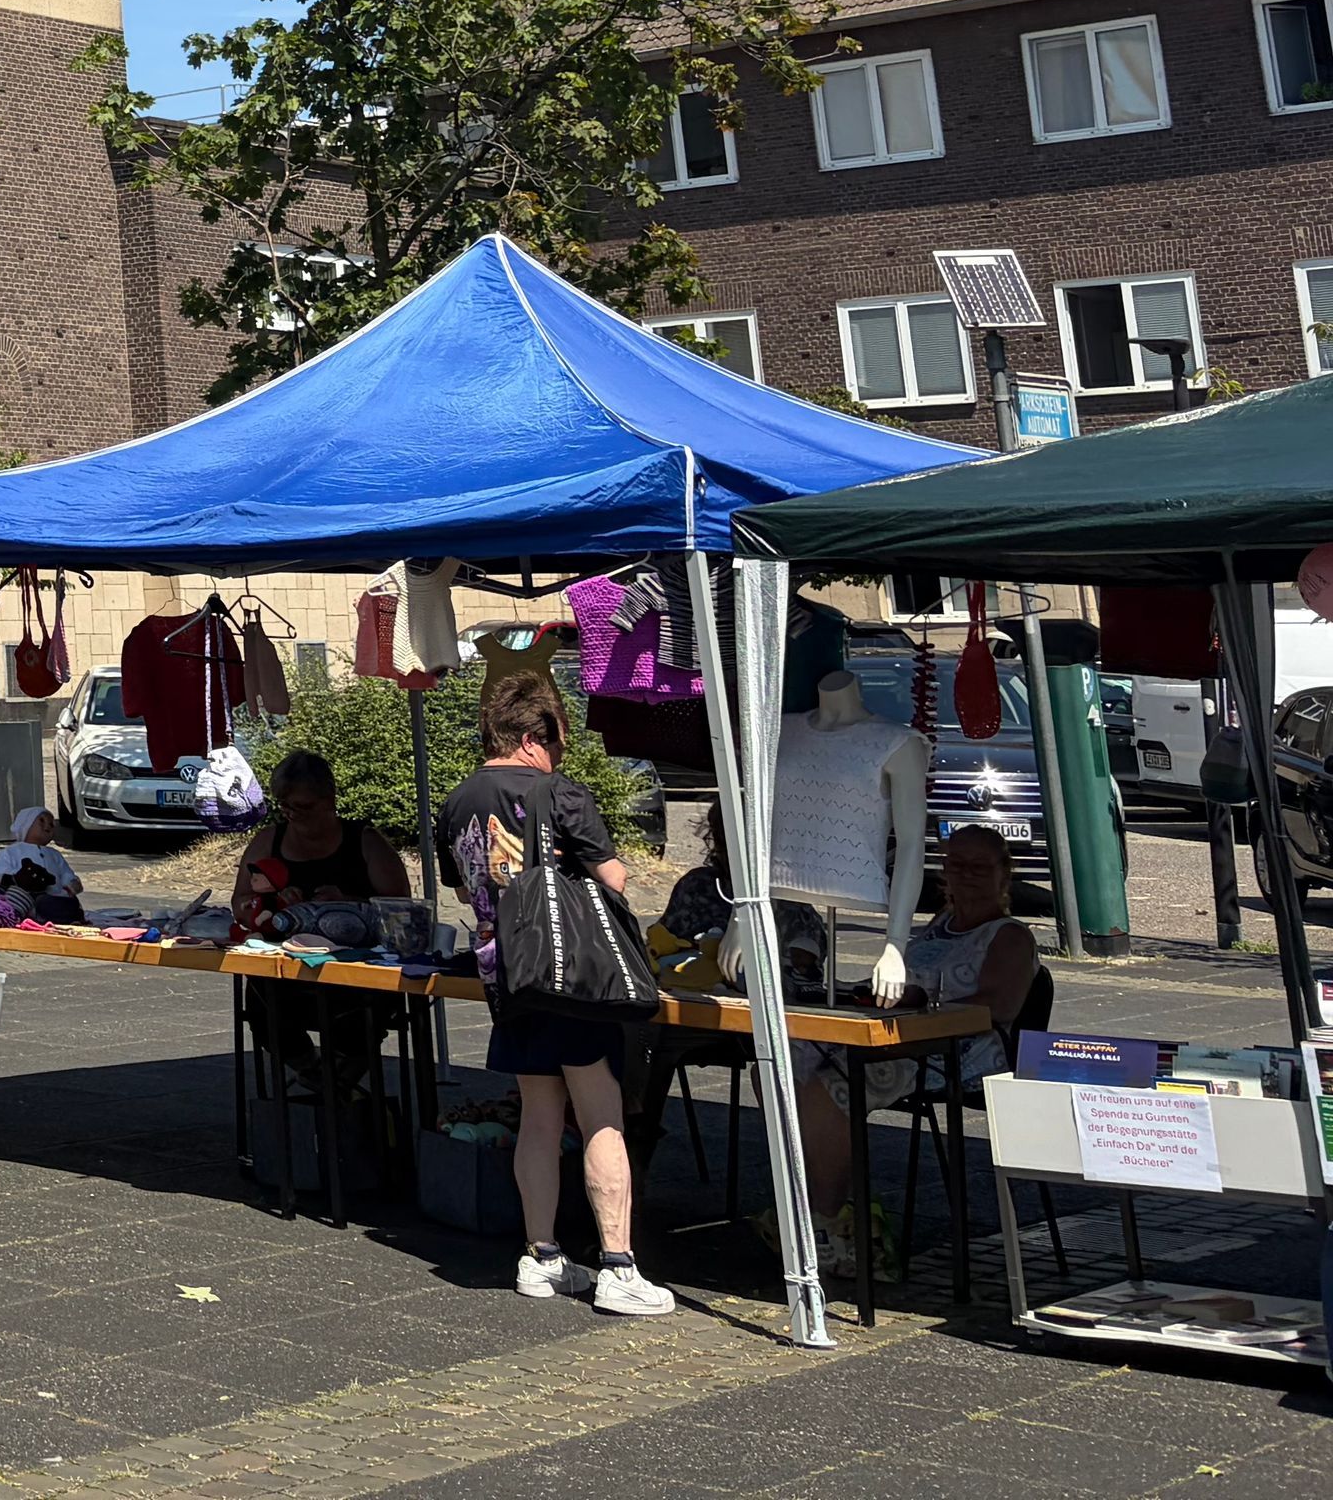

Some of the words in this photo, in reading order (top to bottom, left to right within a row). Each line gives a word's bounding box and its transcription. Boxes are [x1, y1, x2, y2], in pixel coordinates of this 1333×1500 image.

[592, 898, 611, 928] NEVER
[605, 929, 616, 943] DO
[553, 934, 562, 947] DO
[1048, 1050, 1092, 1059] TABALUGA
[1053, 1042, 1080, 1050] PETER
[1082, 1044, 1117, 1053] MAFFAY
[1080, 1092, 1096, 1102] Wir
[1099, 1093, 1132, 1105] freuen
[1134, 1097, 1152, 1106] uns
[1155, 1098, 1171, 1108] auf
[1174, 1100, 1196, 1110] eine
[1091, 1108, 1129, 1120] Spende
[1131, 1113, 1143, 1121] zu
[1145, 1113, 1189, 1124] Gunsten
[1088, 1123, 1104, 1133] der
[1106, 1125, 1197, 1140] Begegnungsstätte
[1158, 1143, 1179, 1153] und
[1181, 1145, 1198, 1155] der
